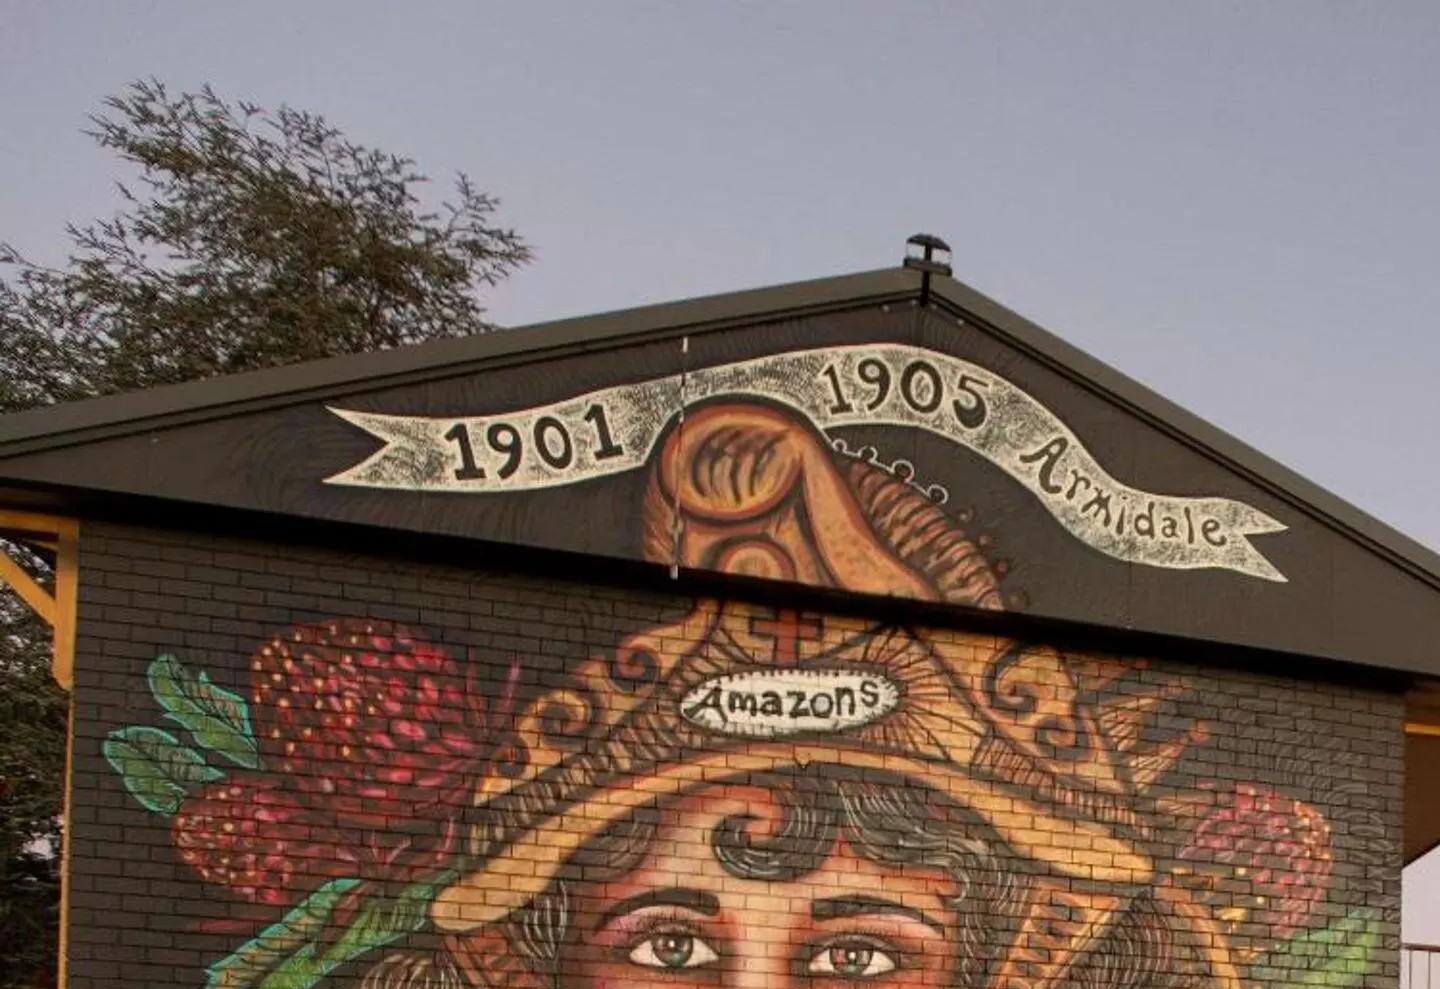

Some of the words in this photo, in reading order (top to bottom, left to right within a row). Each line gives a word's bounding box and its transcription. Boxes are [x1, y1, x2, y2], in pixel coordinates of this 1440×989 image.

[443, 402, 625, 481] 1901
[823, 358, 989, 429] 1905
[1019, 436, 1228, 547] Armidale
[683, 679, 880, 725] Amazons
